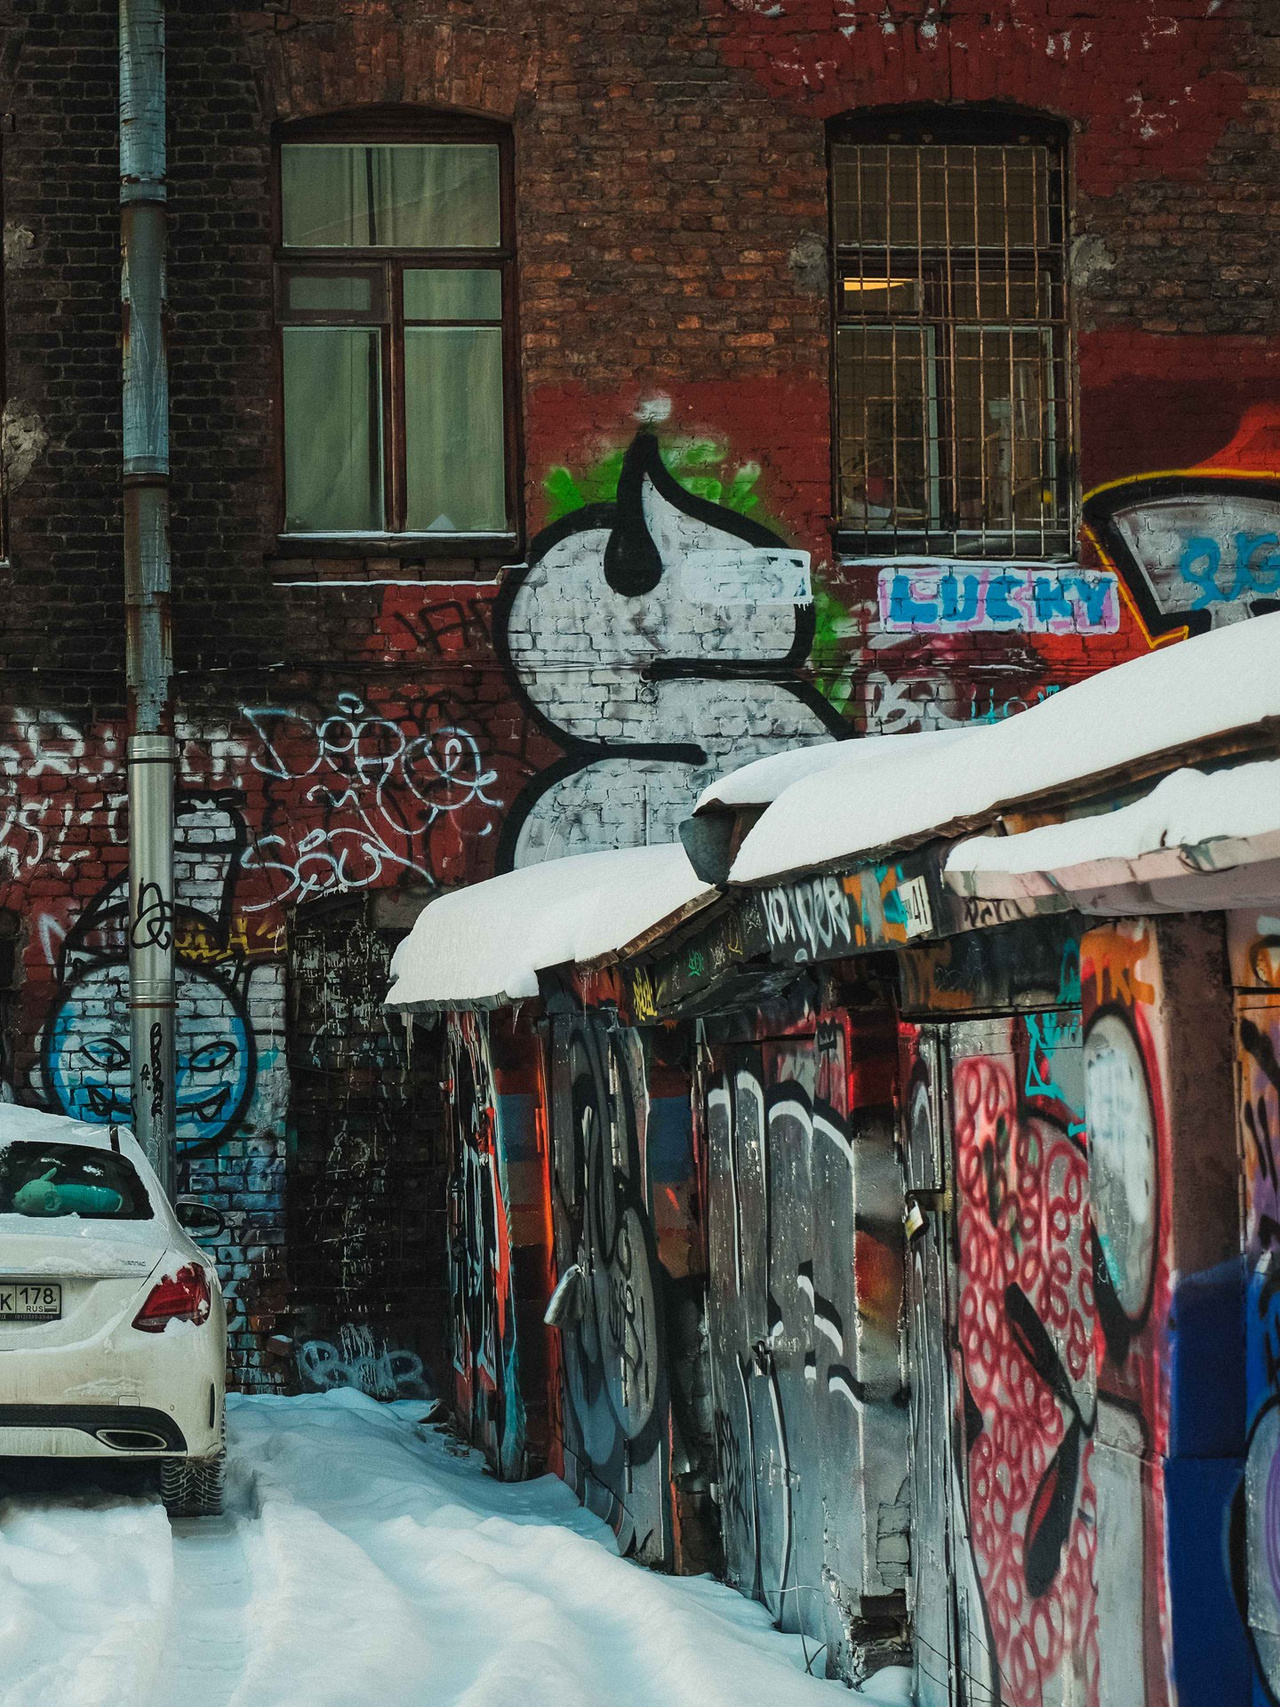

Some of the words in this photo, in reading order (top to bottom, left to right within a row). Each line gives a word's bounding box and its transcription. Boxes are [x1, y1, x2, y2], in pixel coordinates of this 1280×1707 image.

[889, 574, 1116, 626] LUCKY
[19, 1287, 54, 1305] 178
[26, 1305, 44, 1313] RUS
